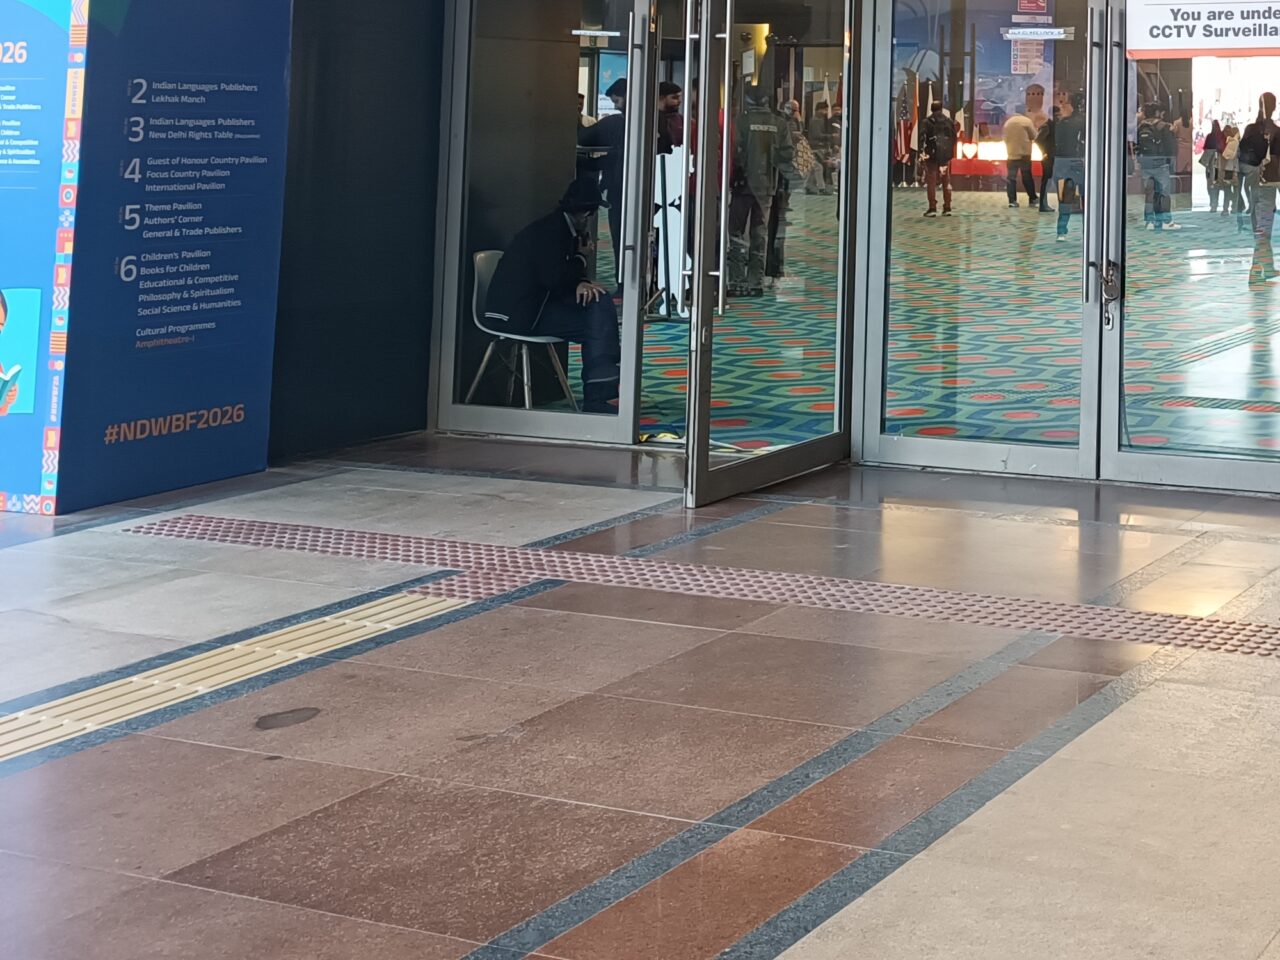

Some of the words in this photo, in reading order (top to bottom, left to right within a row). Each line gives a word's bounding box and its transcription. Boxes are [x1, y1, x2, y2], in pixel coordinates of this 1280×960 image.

[1170, 8, 1201, 21] You
[1207, 10, 1234, 21] are
[1149, 24, 1196, 38] CCTV
[131, 78, 147, 104] 2
[152, 81, 176, 90] Indian
[178, 82, 218, 91] Languages
[220, 83, 258, 92] Publishers
[151, 95, 179, 103] Lekhak
[128, 116, 144, 142] 3
[150, 118, 174, 126] Indian
[175, 118, 216, 127] Languages
[217, 118, 255, 126] Publishers
[149, 131, 166, 139] New
[168, 131, 187, 139] Delhi
[188, 131, 212, 140] Rights
[214, 131, 234, 139] Table
[147, 157, 170, 166] Guest
[171, 157, 180, 165] of
[181, 157, 208, 165] Honour
[210, 157, 239, 166] Country
[240, 156, 267, 164] Pavilion
[124, 158, 142, 184] 4
[146, 170, 169, 178] Focus
[170, 170, 200, 179] Country
[201, 169, 230, 178] Pavilion
[145, 182, 195, 191] International
[196, 182, 226, 190] Pavilion
[144, 203, 171, 212] Theme
[172, 202, 202, 211] Pavilion
[124, 205, 141, 230] 5
[178, 215, 204, 224] Corner
[142, 229, 173, 239] General
[174, 229, 180, 237] &
[182, 228, 203, 237] Trade
[204, 226, 242, 236] Publishers
[181, 249, 211, 259] Pavilion
[120, 255, 137, 282] 6
[140, 266, 165, 276] Books
[166, 264, 177, 273] for
[178, 263, 210, 272] Children
[139, 277, 185, 289] Educational
[187, 277, 193, 285] &
[194, 274, 239, 285] Competitive
[138, 291, 182, 303] Philosophy
[183, 290, 189, 298] &
[190, 287, 235, 299] Spiritualism
[137, 306, 161, 317] Social
[162, 304, 191, 314] Science
[192, 302, 199, 311] &
[199, 299, 242, 310] Humanities
[136, 325, 167, 337] Cultural
[168, 321, 216, 334] Programmes
[104, 404, 245, 444] #NDWBF2026
